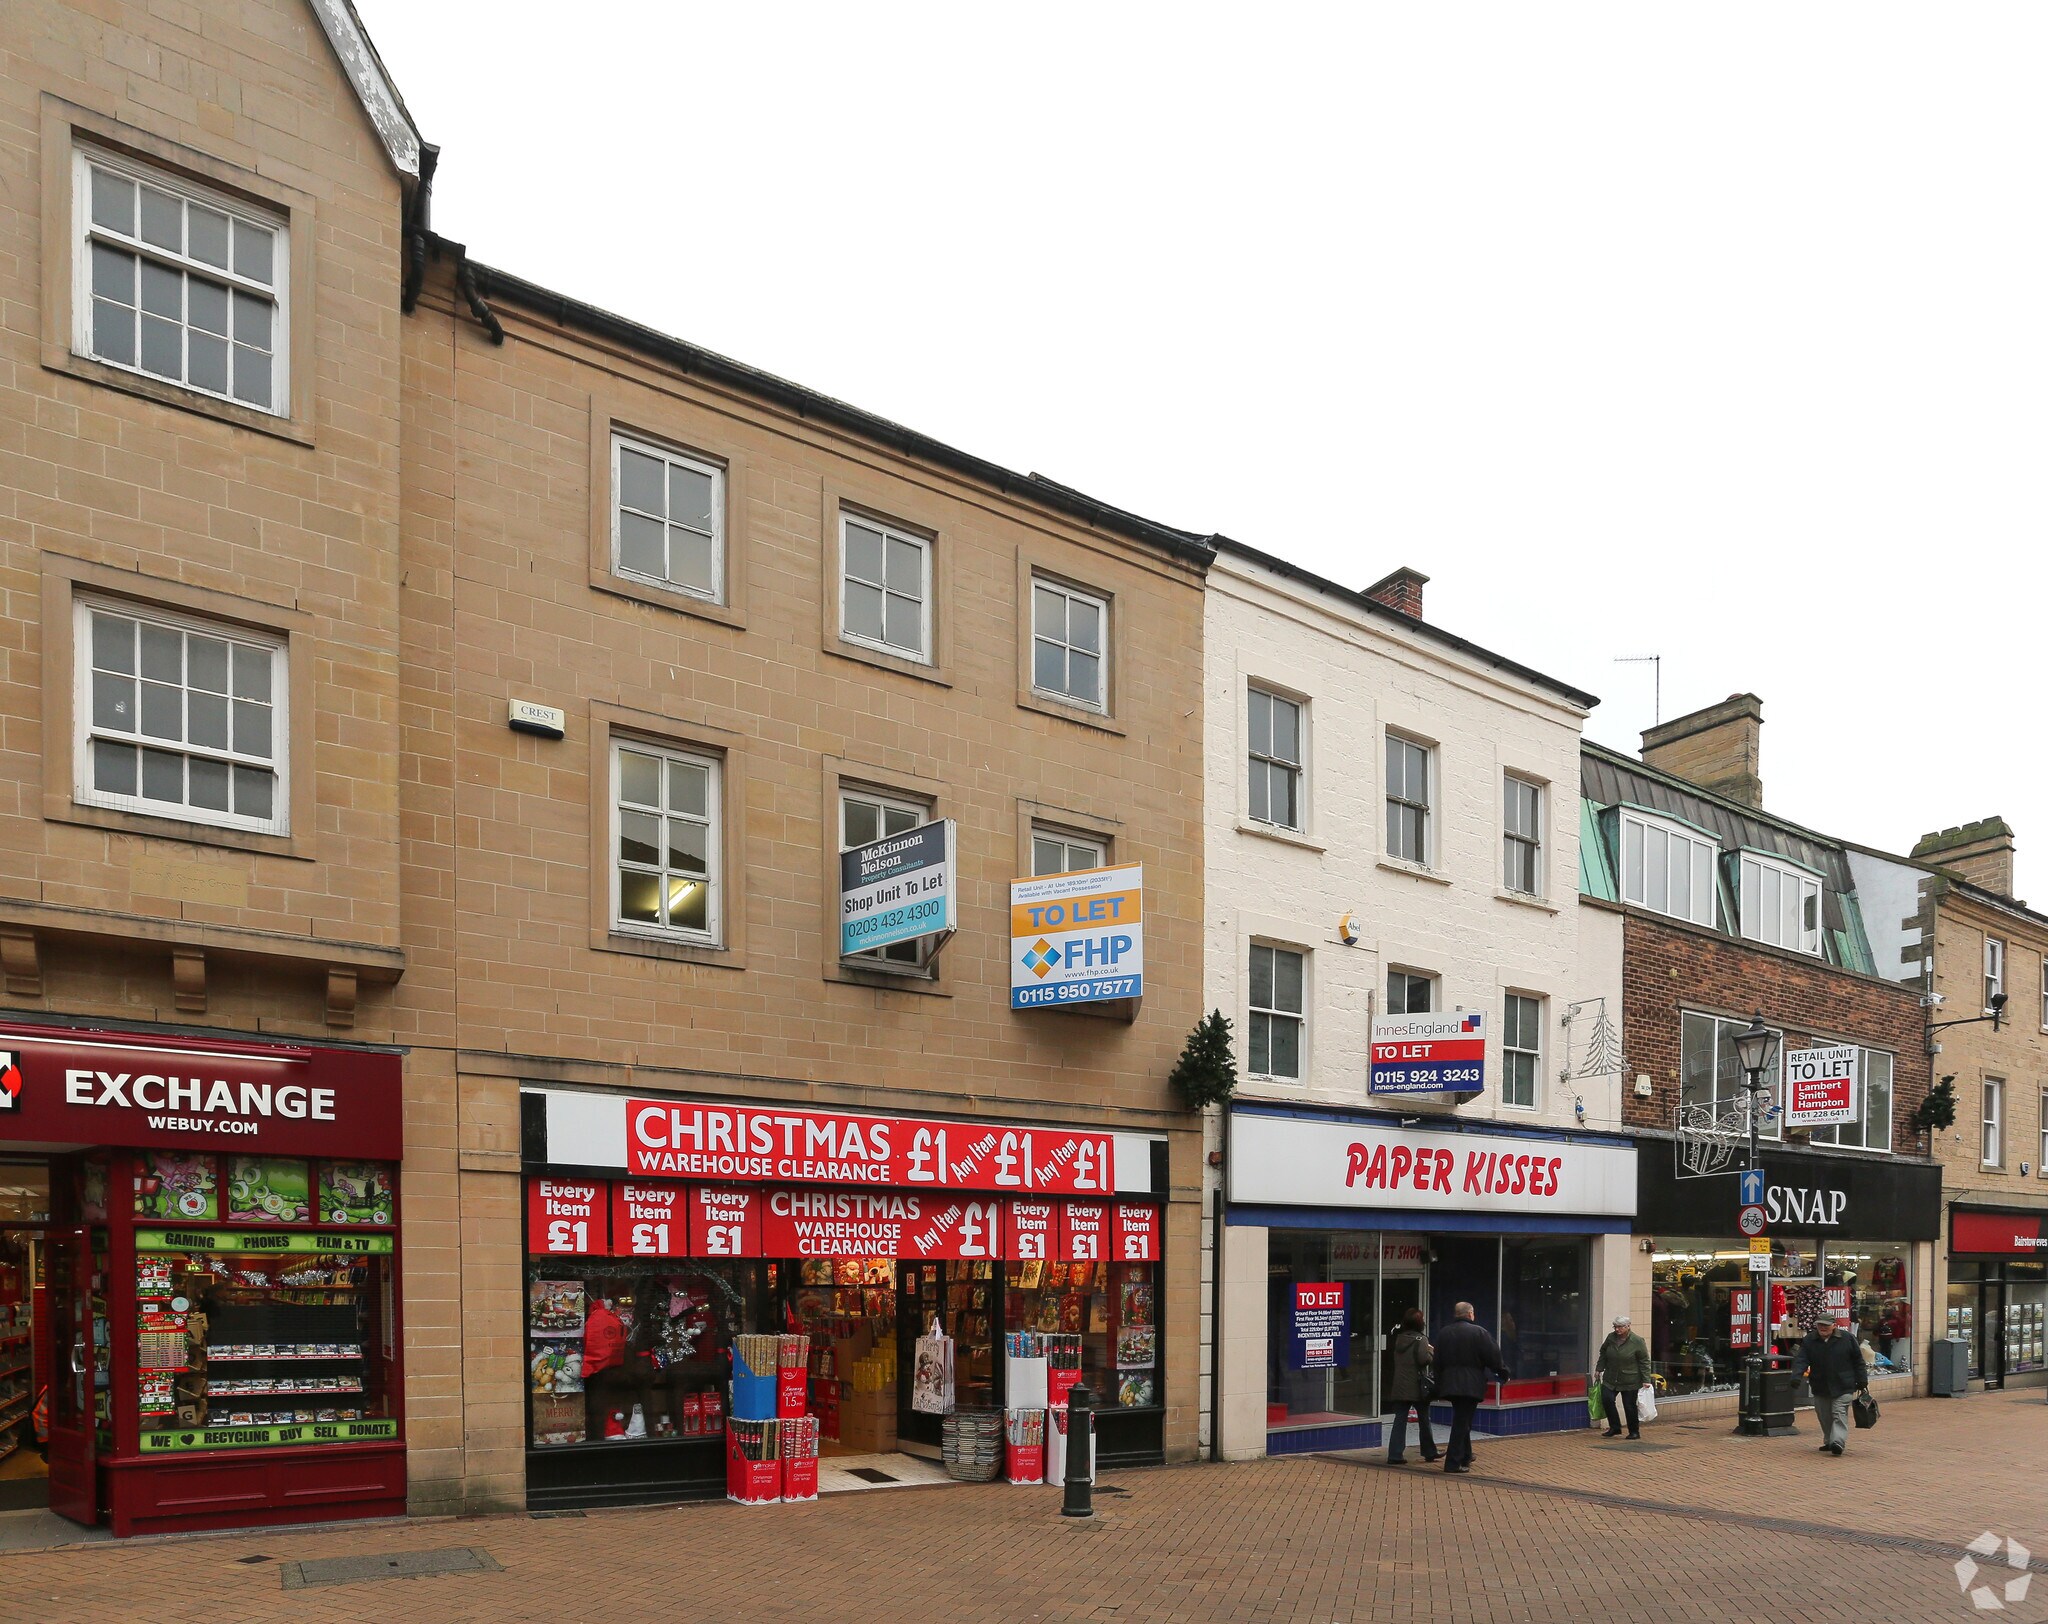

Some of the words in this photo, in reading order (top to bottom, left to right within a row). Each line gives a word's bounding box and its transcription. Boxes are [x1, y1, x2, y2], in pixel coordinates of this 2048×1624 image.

[521, 705, 556, 720] CREST
[861, 833, 923, 862] McKinnon
[860, 854, 902, 876] Nelson
[861, 869, 886, 883] Property
[888, 859, 924, 876] Consultants
[845, 895, 873, 914] Shop
[877, 887, 900, 905] Unit
[905, 880, 919, 897] To
[922, 872, 943, 892] Let
[1018, 891, 1040, 899] Available
[1053, 887, 1070, 895] Vacant
[1072, 884, 1101, 893] Possession
[848, 918, 878, 938] 0203
[881, 910, 904, 929] 432
[907, 901, 939, 922] 4300
[1028, 906, 1064, 927] TO
[1073, 897, 1124, 922] LET
[859, 921, 927, 945] mckinnonnelson.co.uk
[1064, 934, 1132, 969] FHP
[1064, 966, 1119, 979] www.fhp.co.uk
[1019, 988, 1054, 1004] 0115
[1058, 983, 1090, 1000] 950
[1093, 978, 1134, 997] 7577
[1376, 1021, 1459, 1037] InnesEngland
[1376, 1046, 1398, 1059] TO
[1402, 1045, 1432, 1058] LET
[1791, 1052, 1825, 1062] RETAIL
[1828, 1049, 1853, 1059] UNIT
[1375, 1071, 1405, 1083] 0115
[1410, 1070, 1437, 1082] 924
[1443, 1069, 1479, 1081] 3243
[1791, 1063, 1815, 1079] TO
[1823, 1060, 1853, 1077] LET
[65, 1069, 337, 1120] EXCHANGE
[1375, 1082, 1443, 1091] innes-england.com
[1798, 1082, 1842, 1091] Lambert
[1798, 1092, 1827, 1100] Smith
[1798, 1099, 1843, 1108] Hampton
[148, 1115, 258, 1134] WEBUY.COM
[635, 1107, 891, 1162] CHRISTMAS
[907, 1127, 947, 1185] £1
[950, 1154, 978, 1184] Any
[968, 1132, 998, 1161] Item
[995, 1131, 1033, 1188] £1
[1034, 1159, 1060, 1187] Any
[1051, 1138, 1078, 1165] Item
[1072, 1139, 1107, 1191] £1
[637, 1151, 773, 1176] WAREHOUSE
[777, 1159, 890, 1182] CLEARANCE
[1345, 1142, 1455, 1195] PAPER
[1463, 1151, 1562, 1197] KISSES
[540, 1181, 595, 1201] Every
[623, 1185, 675, 1205] Every
[700, 1188, 749, 1208] Every
[546, 1199, 591, 1216] Item
[629, 1203, 672, 1219] Item
[705, 1205, 745, 1222] Item
[1012, 1201, 1050, 1219] Every
[1066, 1203, 1102, 1220] Every
[1119, 1205, 1152, 1221] Every
[1766, 1186, 1846, 1225] SNAP
[771, 1192, 920, 1220] CHRISTMAS
[913, 1227, 943, 1256] Any
[931, 1204, 961, 1234] Item
[958, 1202, 997, 1258] £1
[794, 1221, 901, 1239] WAREHOUSE
[1017, 1216, 1047, 1230] Item
[1070, 1218, 1099, 1231] Item
[1123, 1218, 1150, 1232] Item
[165, 1233, 215, 1248] GAMING
[243, 1236, 289, 1249] PHONES
[316, 1236, 343, 1248] FILM
[344, 1240, 353, 1249] &
[355, 1239, 370, 1250] TV
[548, 1220, 588, 1252] £1
[631, 1223, 669, 1254] £1
[707, 1225, 742, 1255] £1
[2014, 1235, 2036, 1247] Bairstow
[798, 1239, 898, 1255] CLEARANCE
[1018, 1233, 1045, 1258] £1
[1072, 1234, 1098, 1259] £1
[1124, 1235, 1149, 1259] £1
[1334, 1245, 1360, 1260] CARD
[1299, 1292, 1316, 1305] TO
[1319, 1292, 1340, 1305] LET
[1828, 1290, 1845, 1306] SALE
[1731, 1314, 1745, 1325] MANY
[1835, 1307, 1849, 1318] ITEMS
[1732, 1328, 1741, 1344] £5
[1742, 1333, 1748, 1343] or
[182, 1411, 193, 1421] G
[545, 1407, 573, 1418] MERRY
[151, 1434, 171, 1447] WE
[204, 1430, 270, 1445] RECYCLING
[279, 1427, 302, 1442] BUY
[313, 1425, 338, 1438] SELL
[348, 1423, 390, 1437] DONATE
